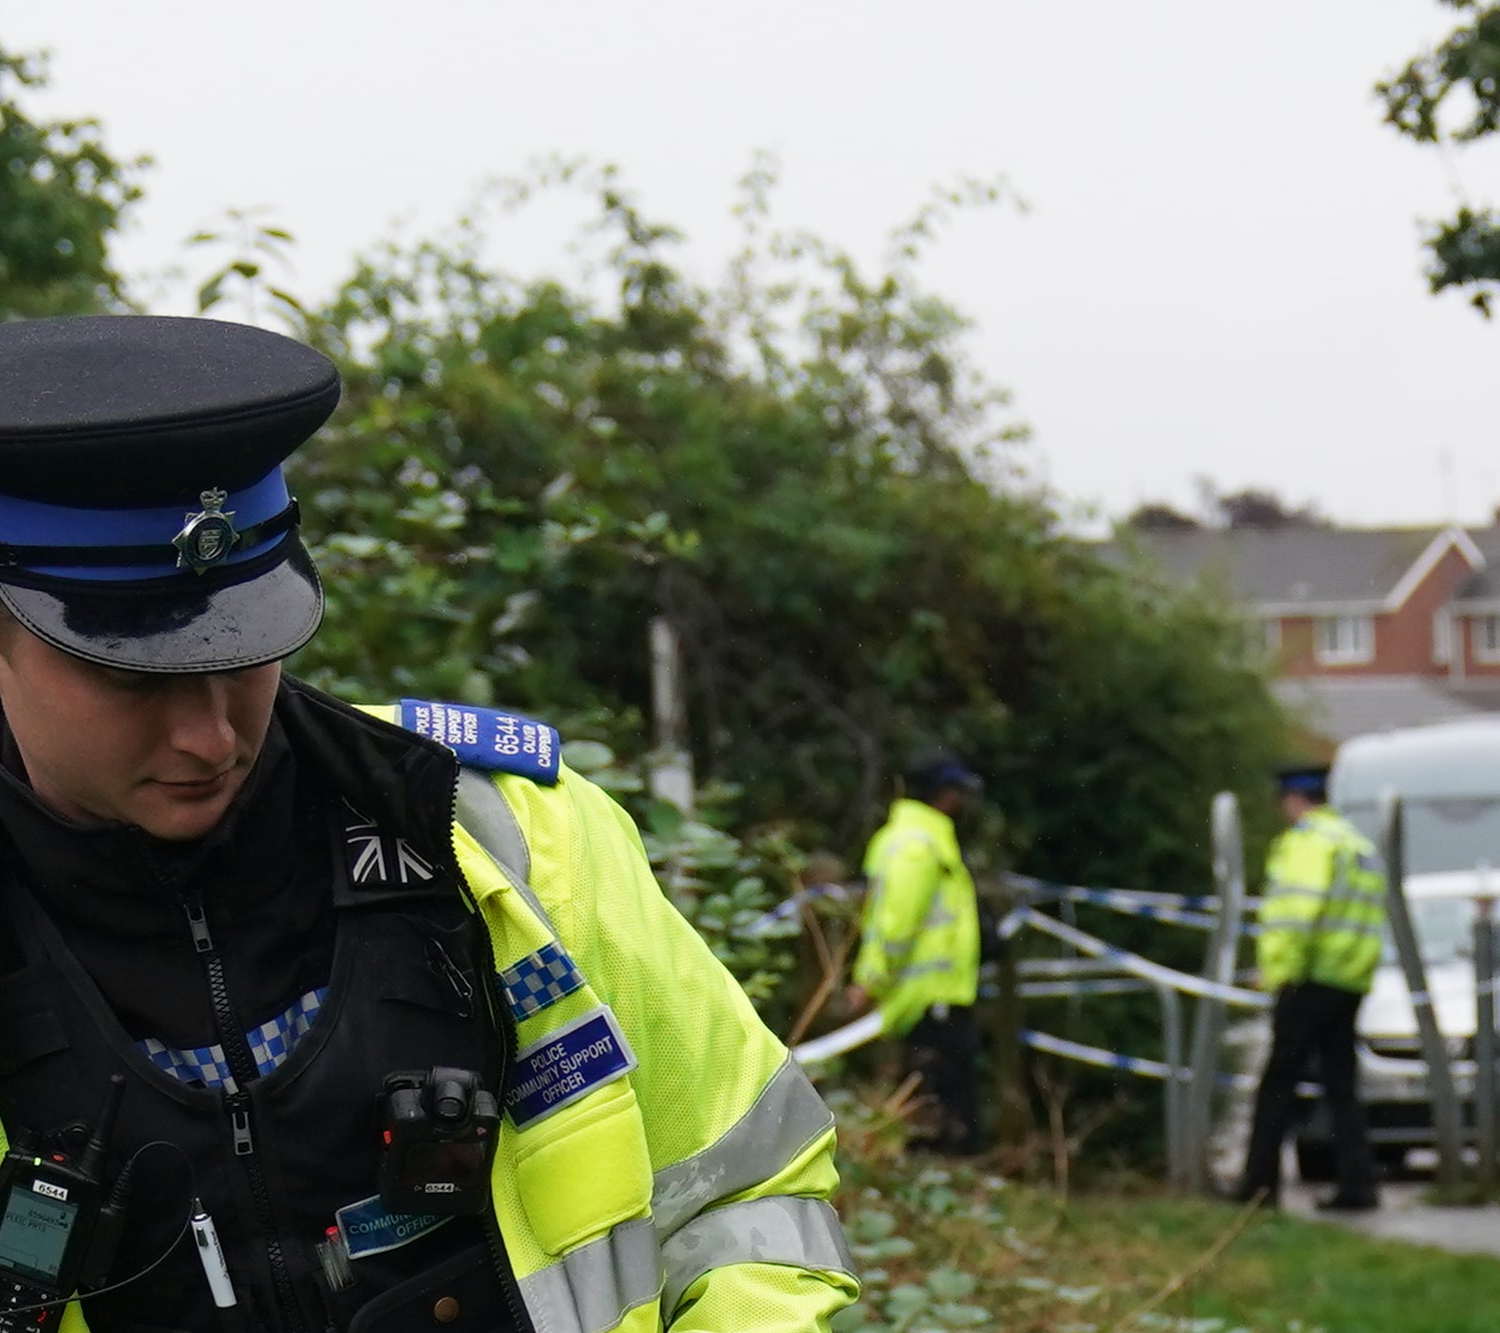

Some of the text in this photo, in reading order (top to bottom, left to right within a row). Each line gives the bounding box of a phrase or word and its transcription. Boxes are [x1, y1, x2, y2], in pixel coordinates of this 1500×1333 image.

[495, 716, 520, 755] 6544
[523, 725, 536, 754] OLIVER
[506, 1036, 613, 1105] COMMUNITY SUPPORT
[530, 1042, 567, 1073] POLICE
[542, 1072, 586, 1104] OFFICER
[39, 1184, 65, 1199] 6544
